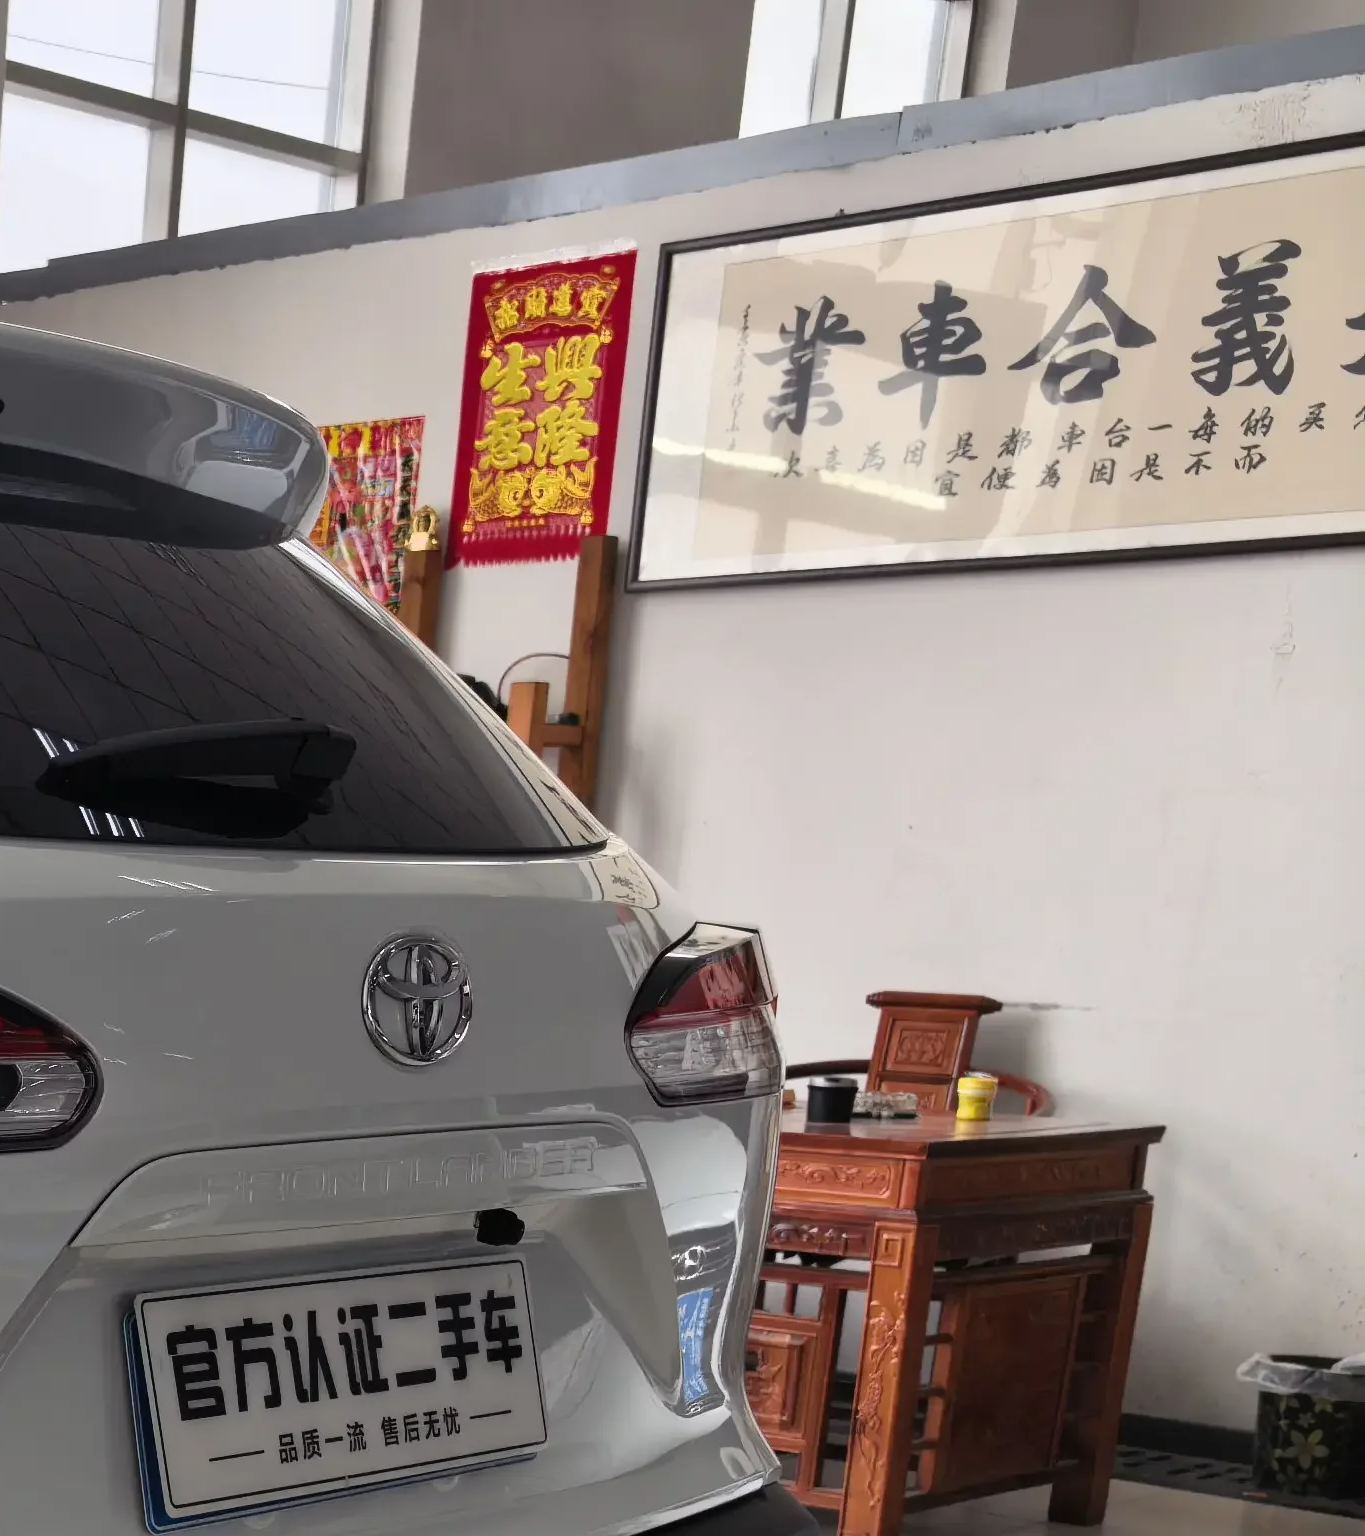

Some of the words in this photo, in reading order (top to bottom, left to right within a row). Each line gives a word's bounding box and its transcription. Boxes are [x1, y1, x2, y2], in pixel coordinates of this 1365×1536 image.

[166, 1288, 524, 1422] 官方认证二手车
[277, 1421, 369, 1464] 品质一流
[380, 1405, 462, 1447] 售后无忧
